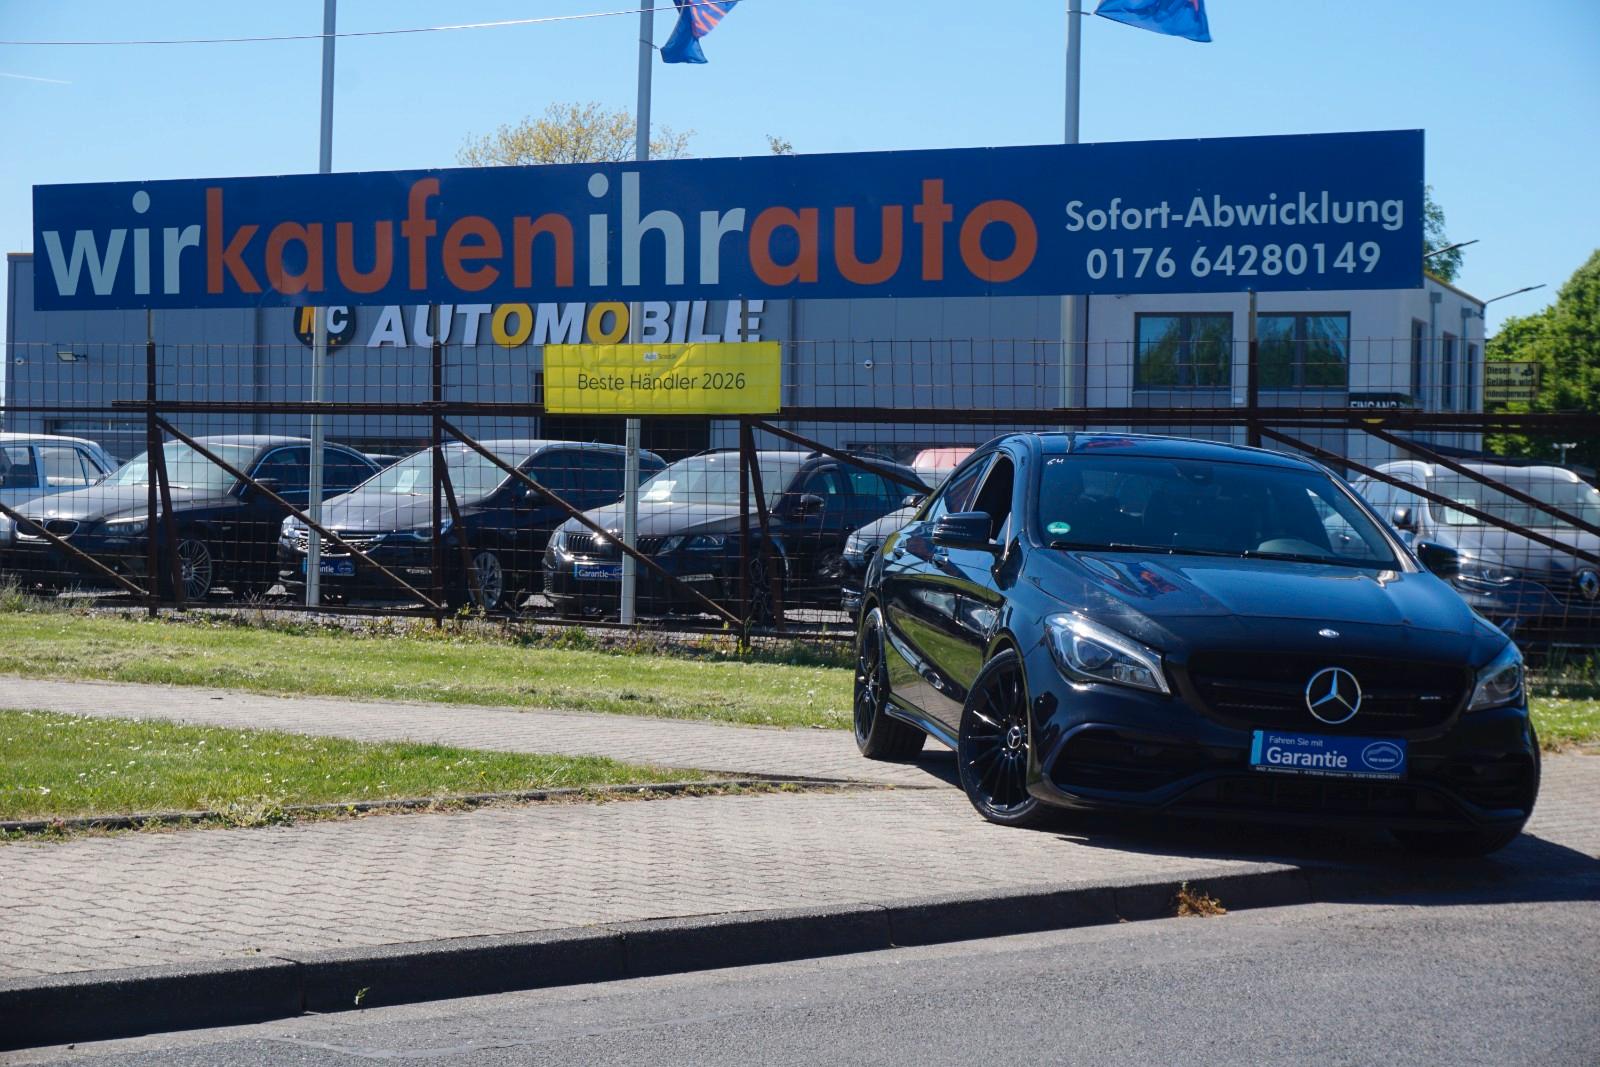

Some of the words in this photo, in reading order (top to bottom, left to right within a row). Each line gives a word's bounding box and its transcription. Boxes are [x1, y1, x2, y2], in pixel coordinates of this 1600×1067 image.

[1065, 191, 1405, 232] Sofort-Abwicklung
[42, 171, 1038, 297] wirkaufenihrauto
[1086, 247, 1177, 279] 0176
[1190, 241, 1381, 278] 64280149
[367, 299, 764, 348] AUTOMOBILE
[578, 373, 625, 391] Beste
[630, 373, 698, 390] Händler
[702, 371, 746, 390] 2026
[1266, 746, 1348, 769] Garantie
[1269, 735, 1296, 745] Fahren
[1297, 737, 1310, 746] Sie
[1310, 739, 1324, 748] mit
